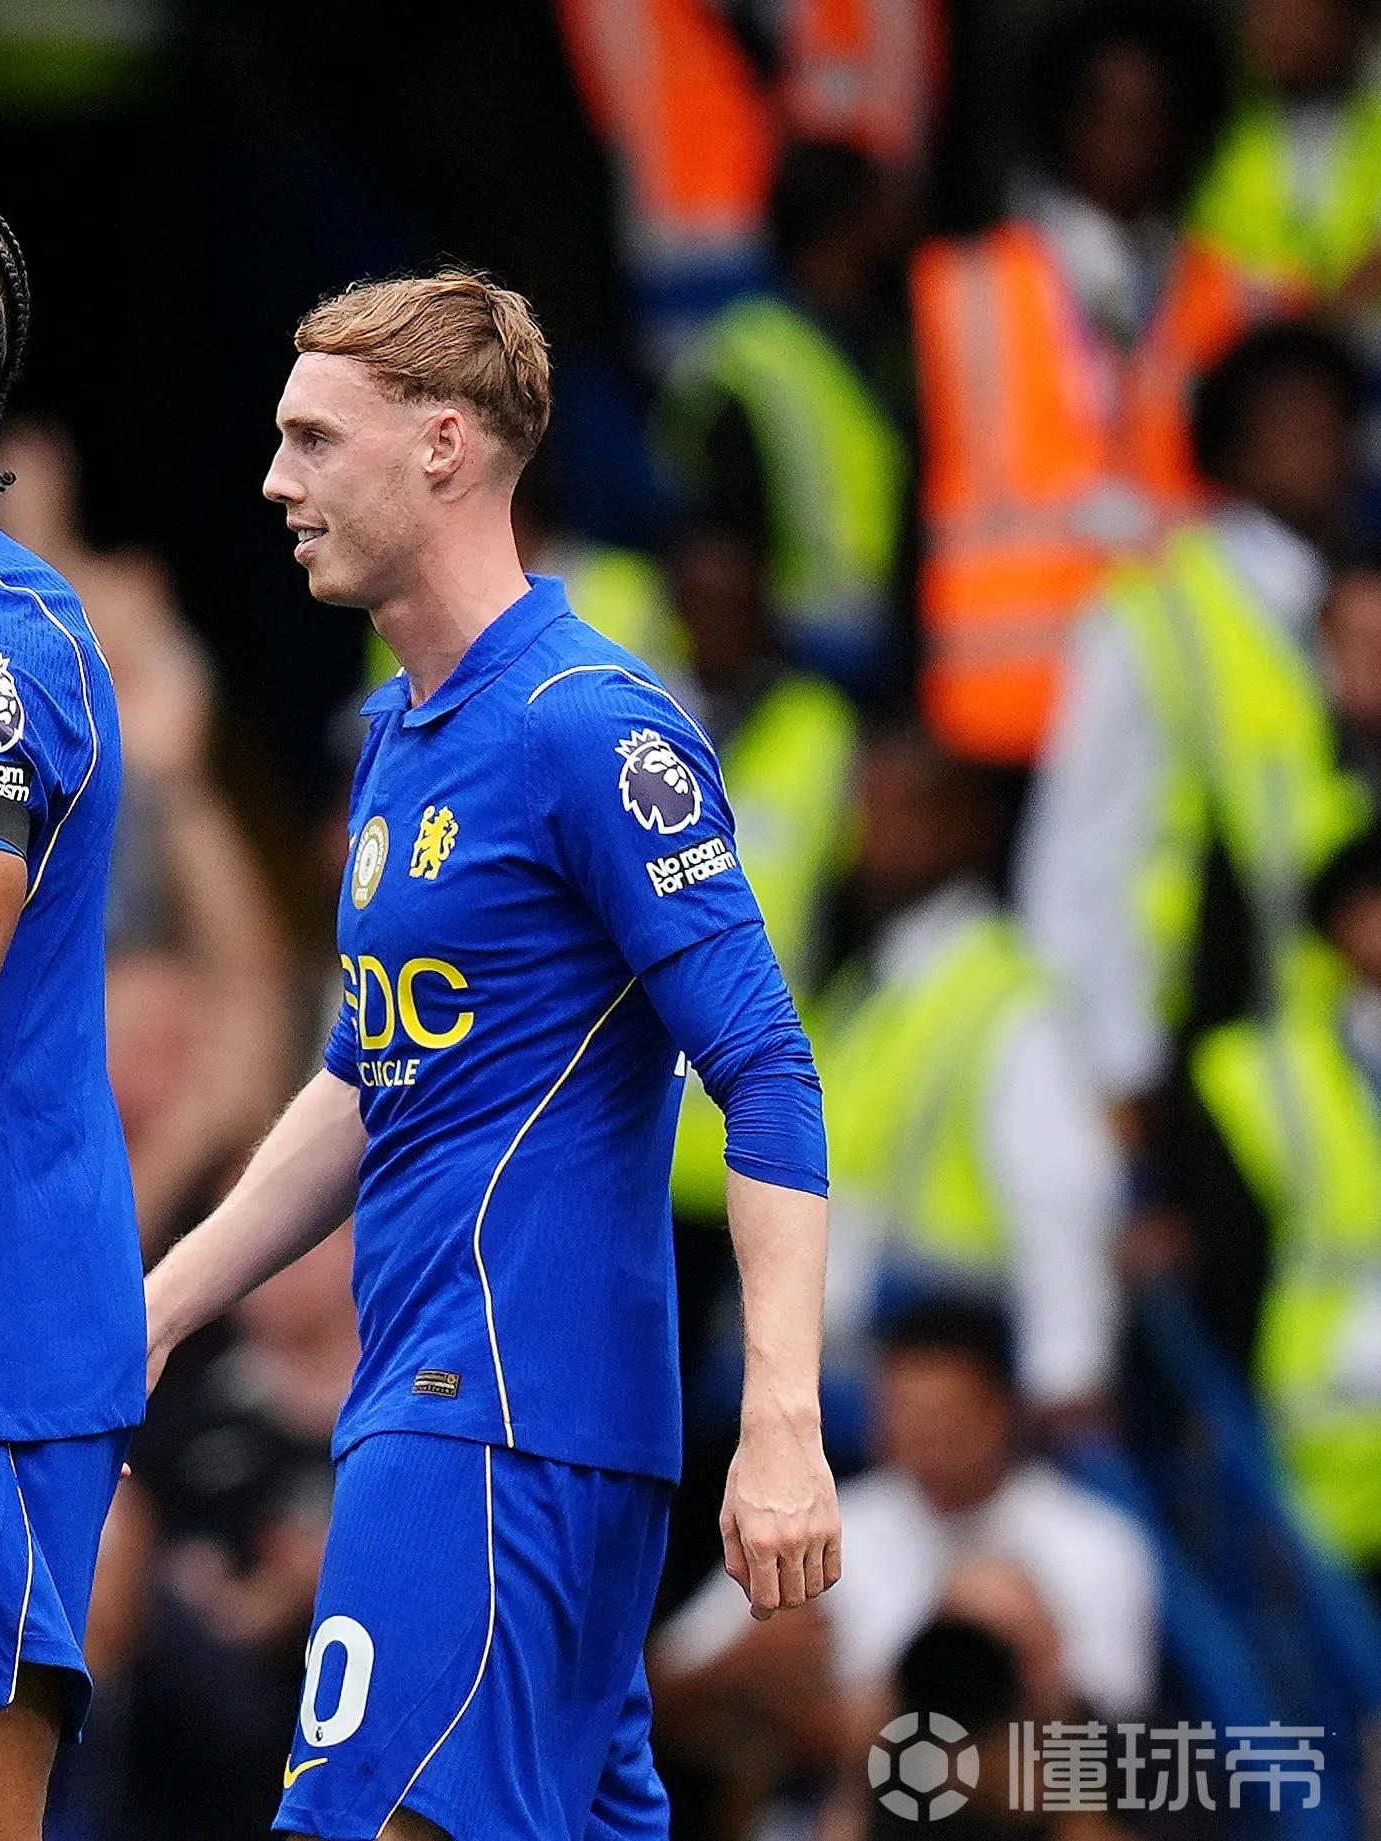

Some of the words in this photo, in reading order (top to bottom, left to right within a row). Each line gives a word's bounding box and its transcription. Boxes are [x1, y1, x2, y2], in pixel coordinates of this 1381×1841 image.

[646, 857, 681, 878] No
[679, 838, 726, 869] room
[653, 872, 684, 897] for
[684, 851, 737, 885] racism
